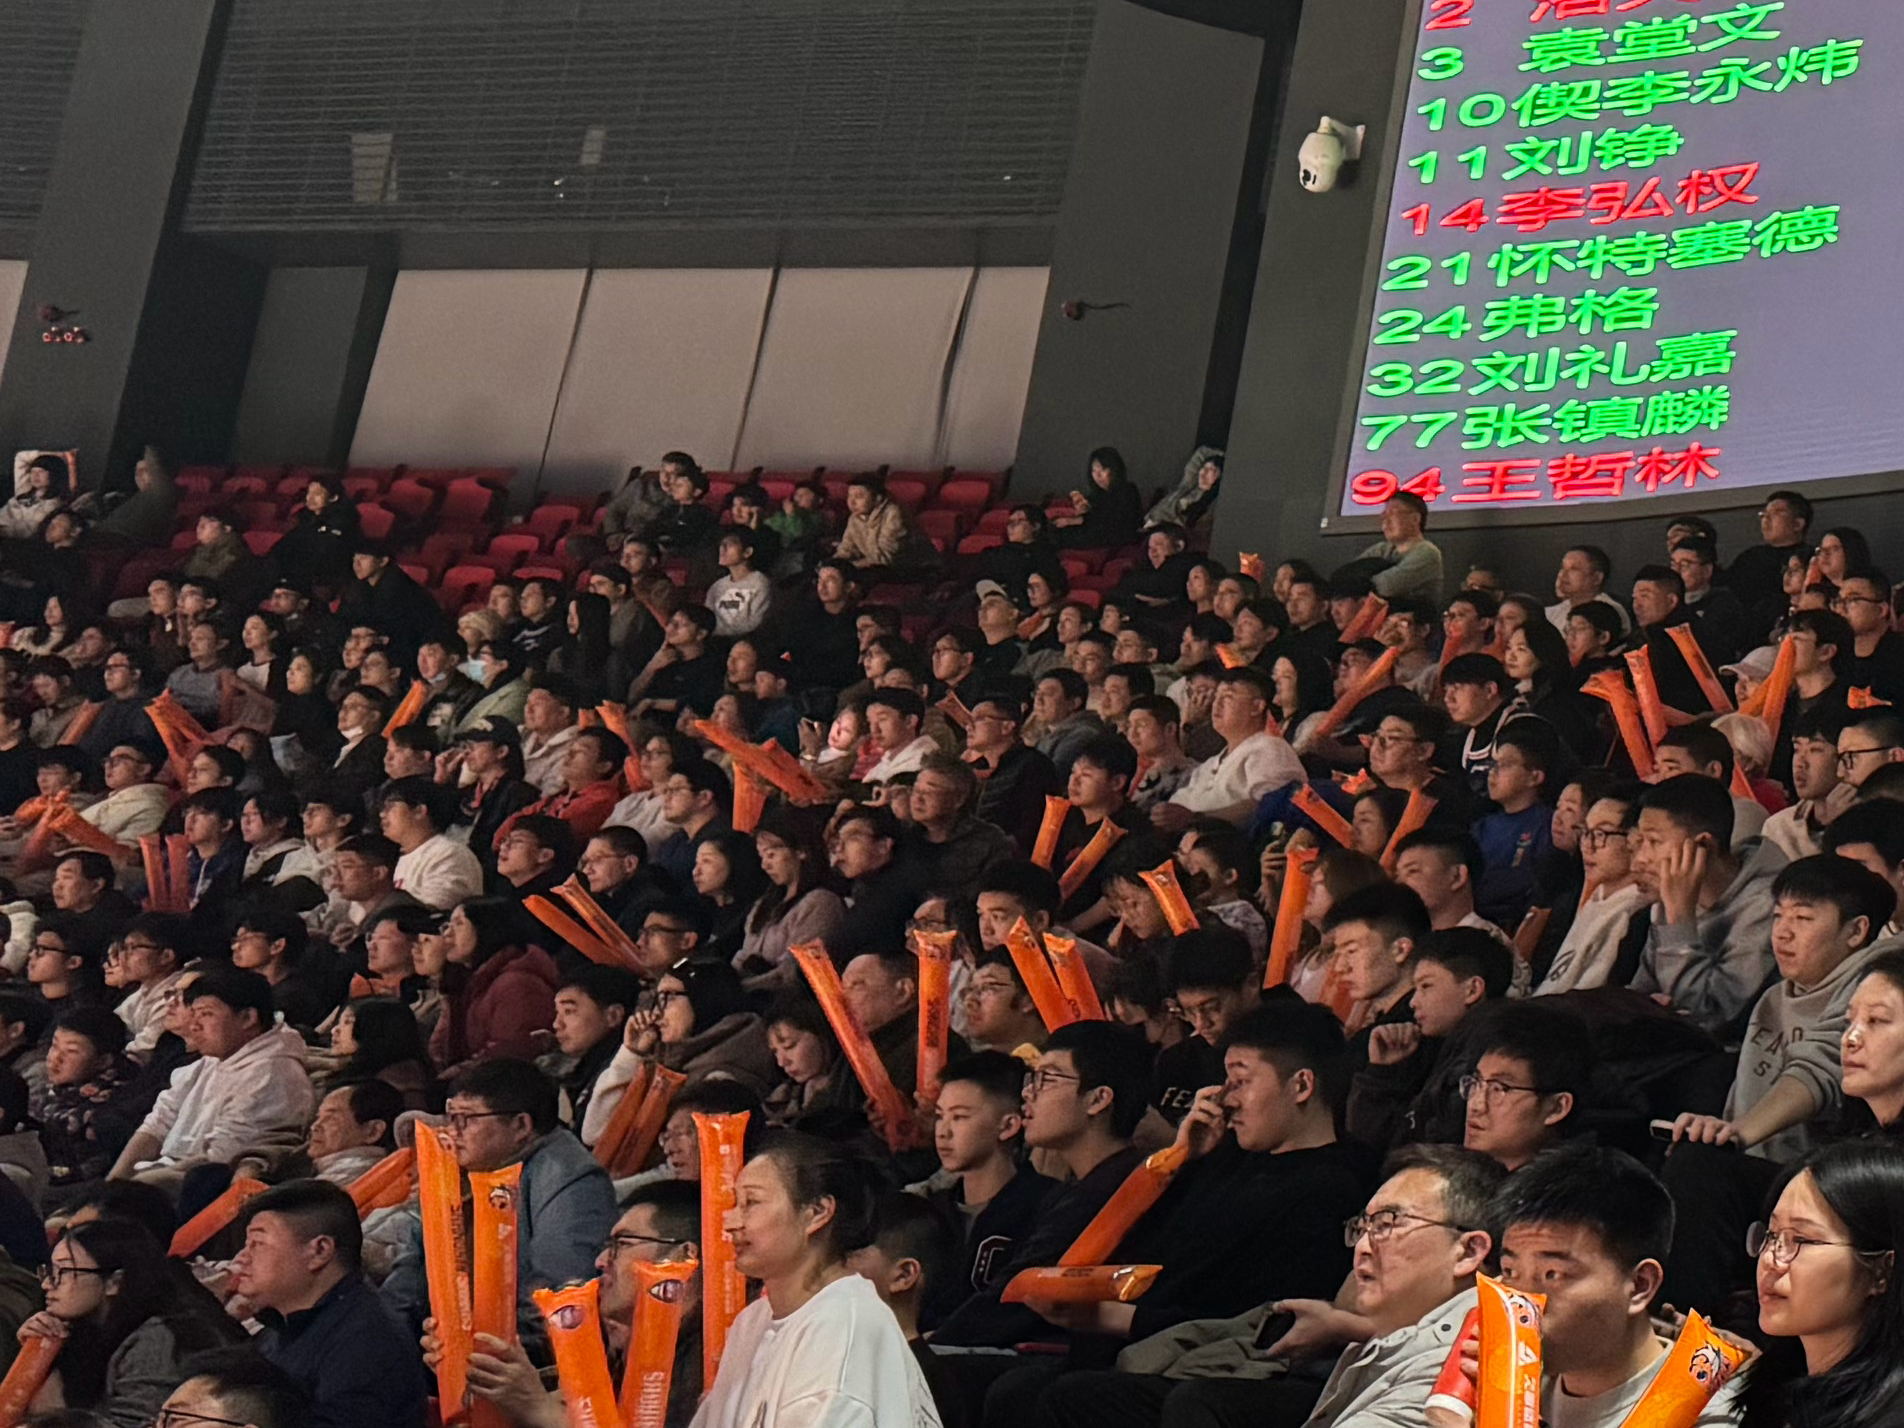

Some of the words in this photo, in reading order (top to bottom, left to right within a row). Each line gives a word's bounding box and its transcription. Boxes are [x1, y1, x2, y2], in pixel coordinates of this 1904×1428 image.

[1418, 47, 1464, 79] 3
[1520, 3, 1784, 73] 袁堂文
